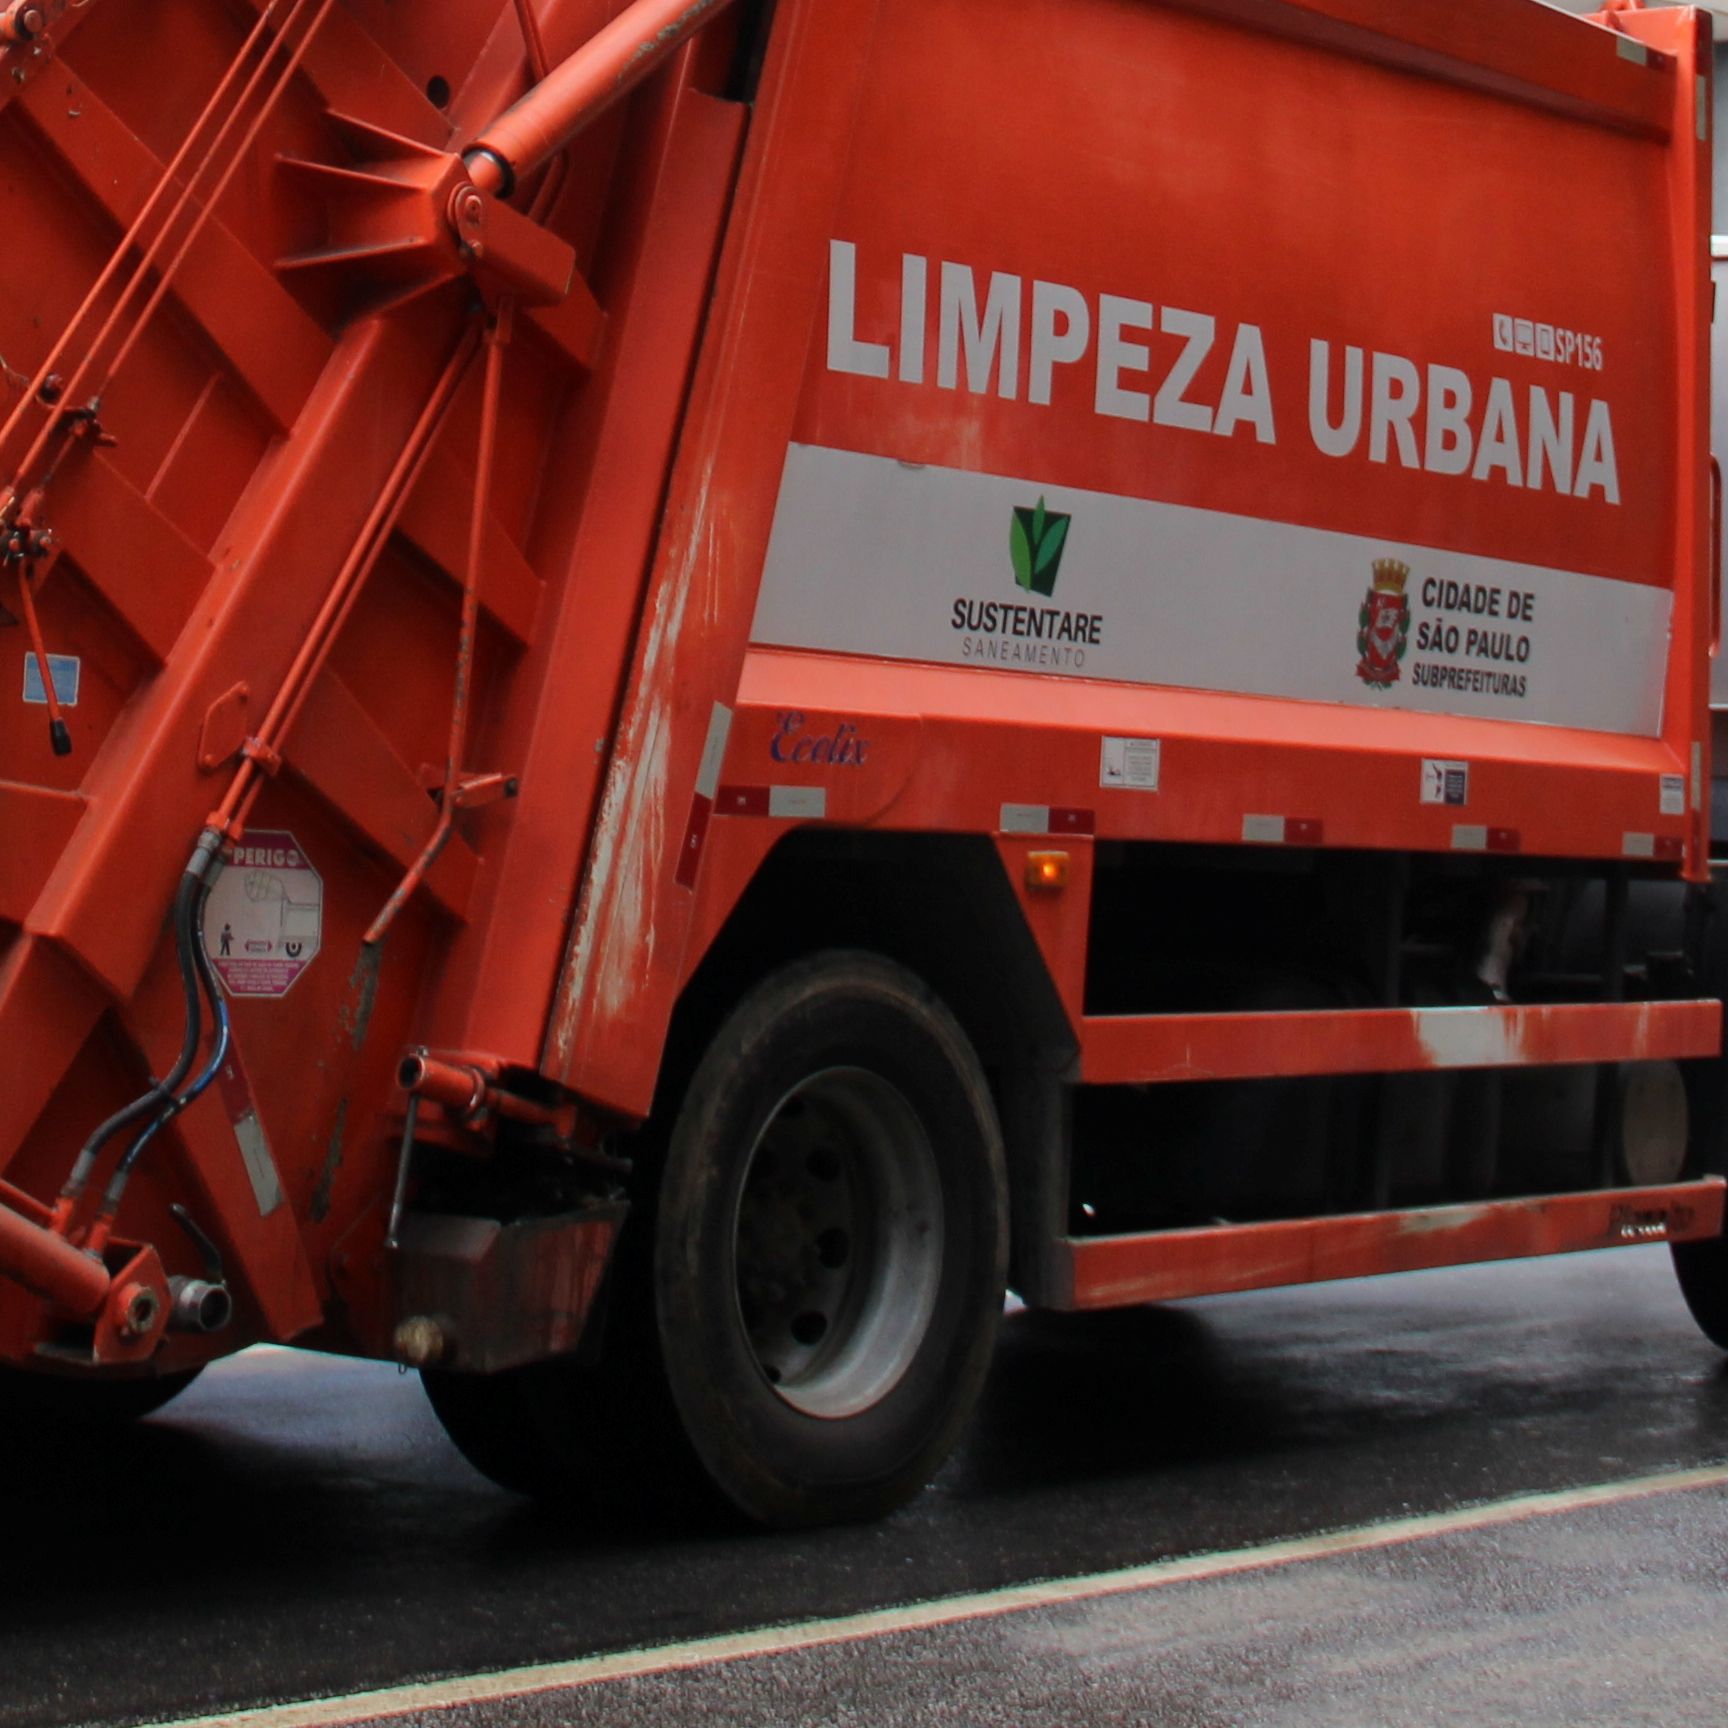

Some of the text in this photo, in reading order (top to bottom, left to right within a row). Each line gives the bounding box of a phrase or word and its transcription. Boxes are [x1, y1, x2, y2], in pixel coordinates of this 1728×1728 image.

[1555, 327, 1603, 371] SP156
[826, 239, 1621, 506] LIMPEZA URBANA
[951, 597, 1103, 645] SUSTENTARE
[1422, 577, 1535, 622] CIDADE DE
[962, 636, 1086, 668] SANEAMENTO
[1416, 617, 1531, 663] SÃO PAULO
[1412, 661, 1528, 698] SUBPREFEITURAS
[233, 847, 301, 867] PERIGO
